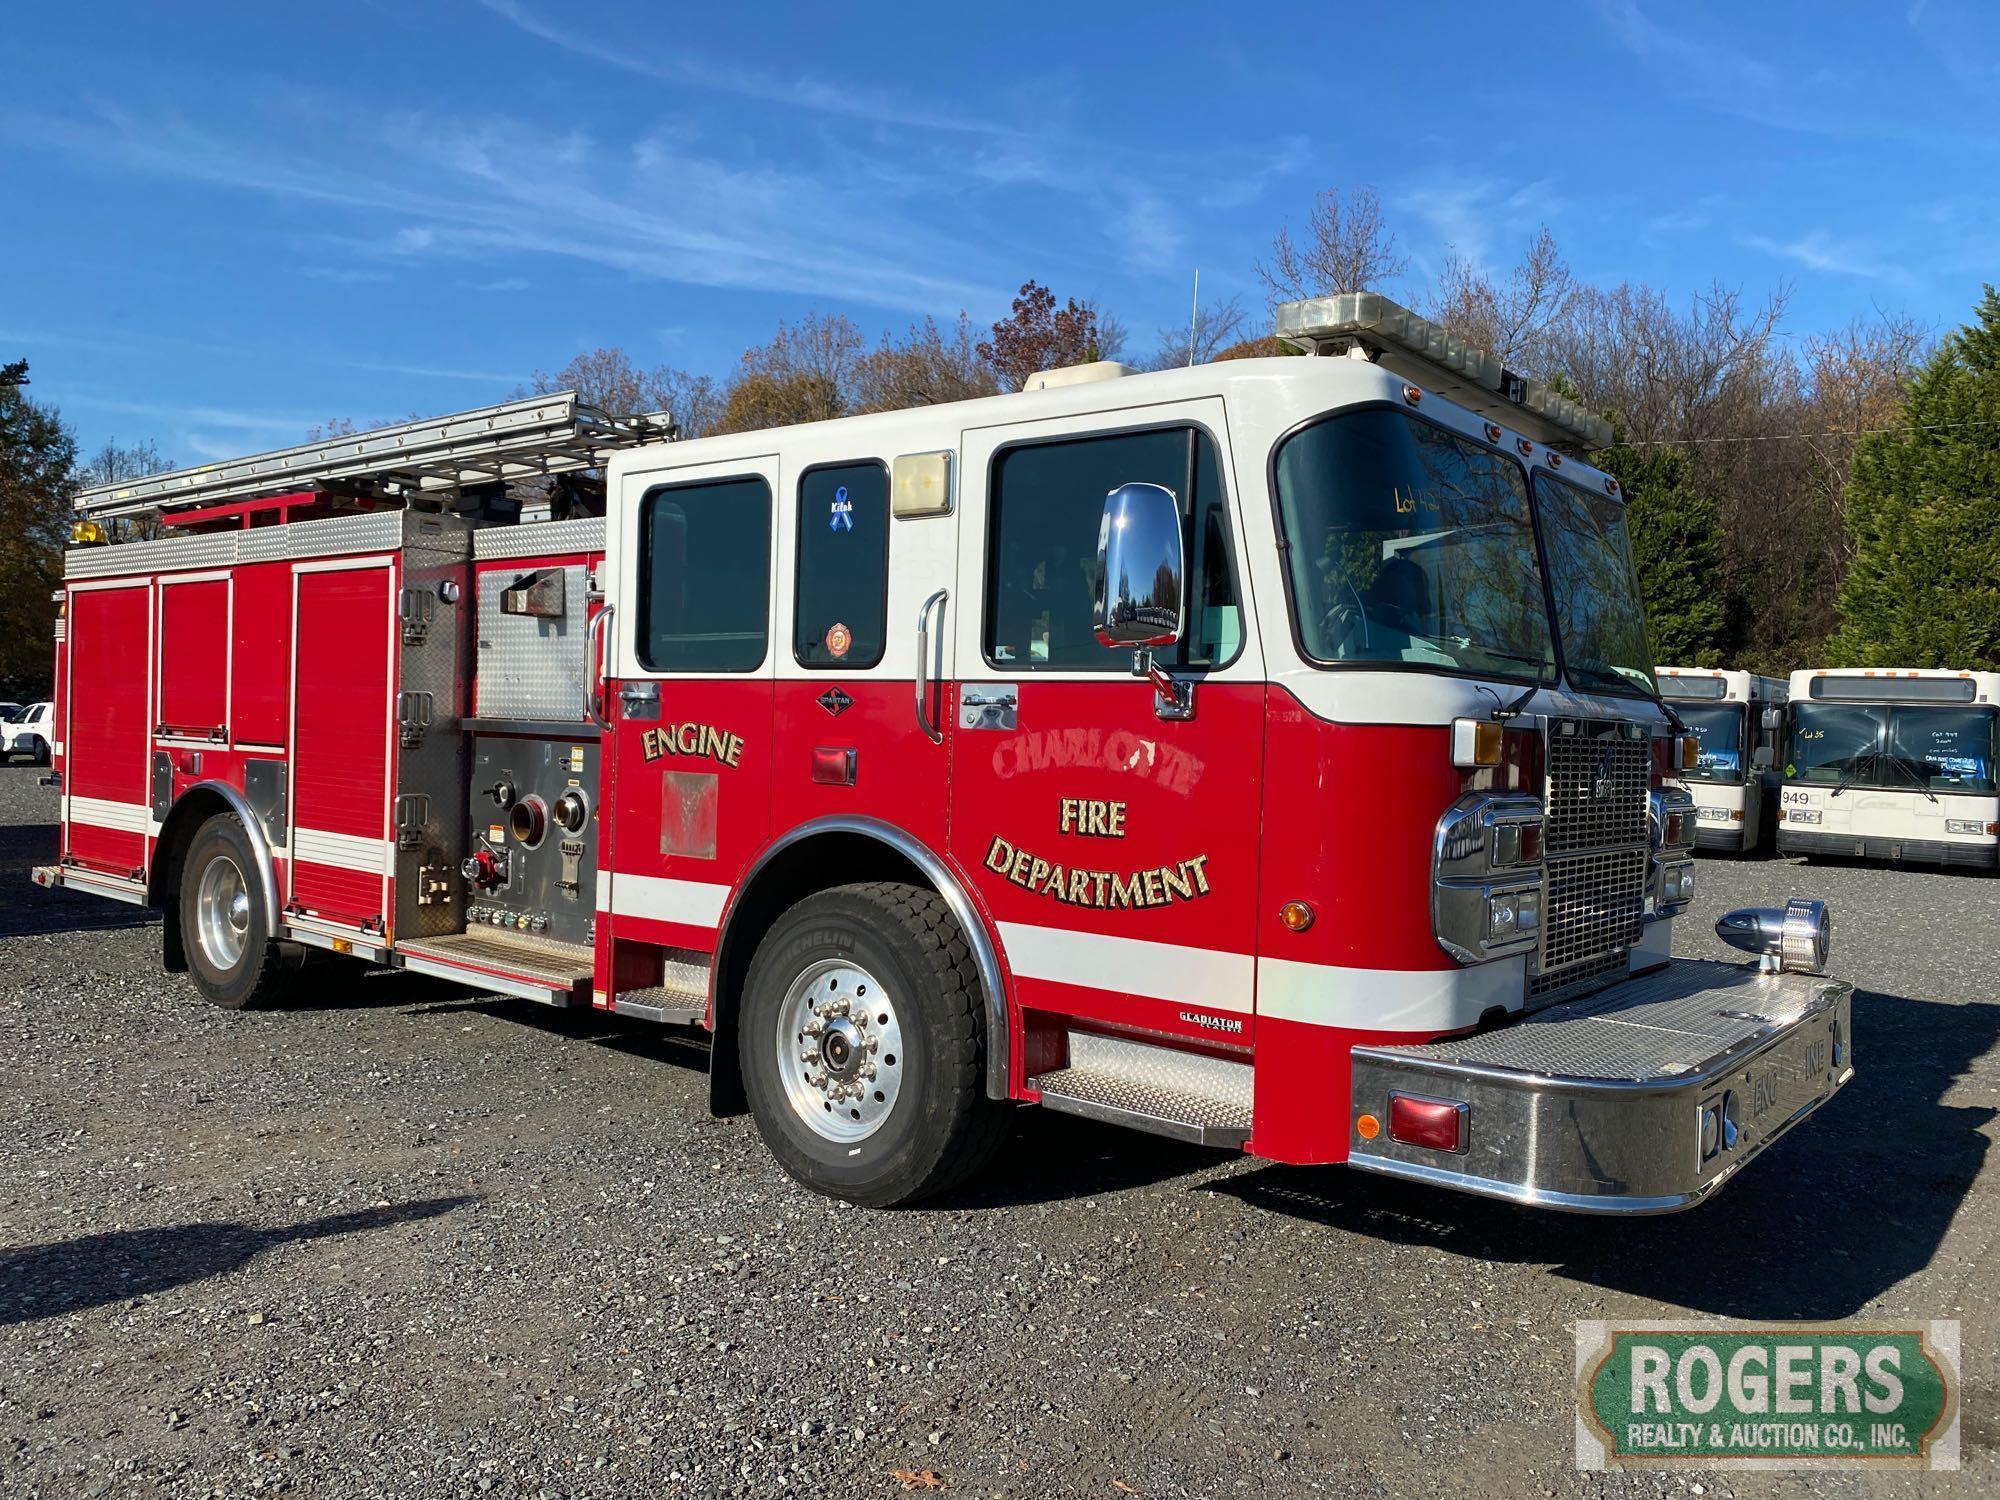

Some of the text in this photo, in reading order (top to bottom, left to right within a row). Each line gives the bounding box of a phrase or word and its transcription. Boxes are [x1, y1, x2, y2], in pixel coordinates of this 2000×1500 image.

[641, 722, 745, 769] ENGINE
[1782, 791, 1809, 804] 949
[1058, 798, 1127, 839] FIRE
[984, 834, 1211, 910] DEPARTMENT
[1179, 1012, 1242, 1029] GLADIATOR
